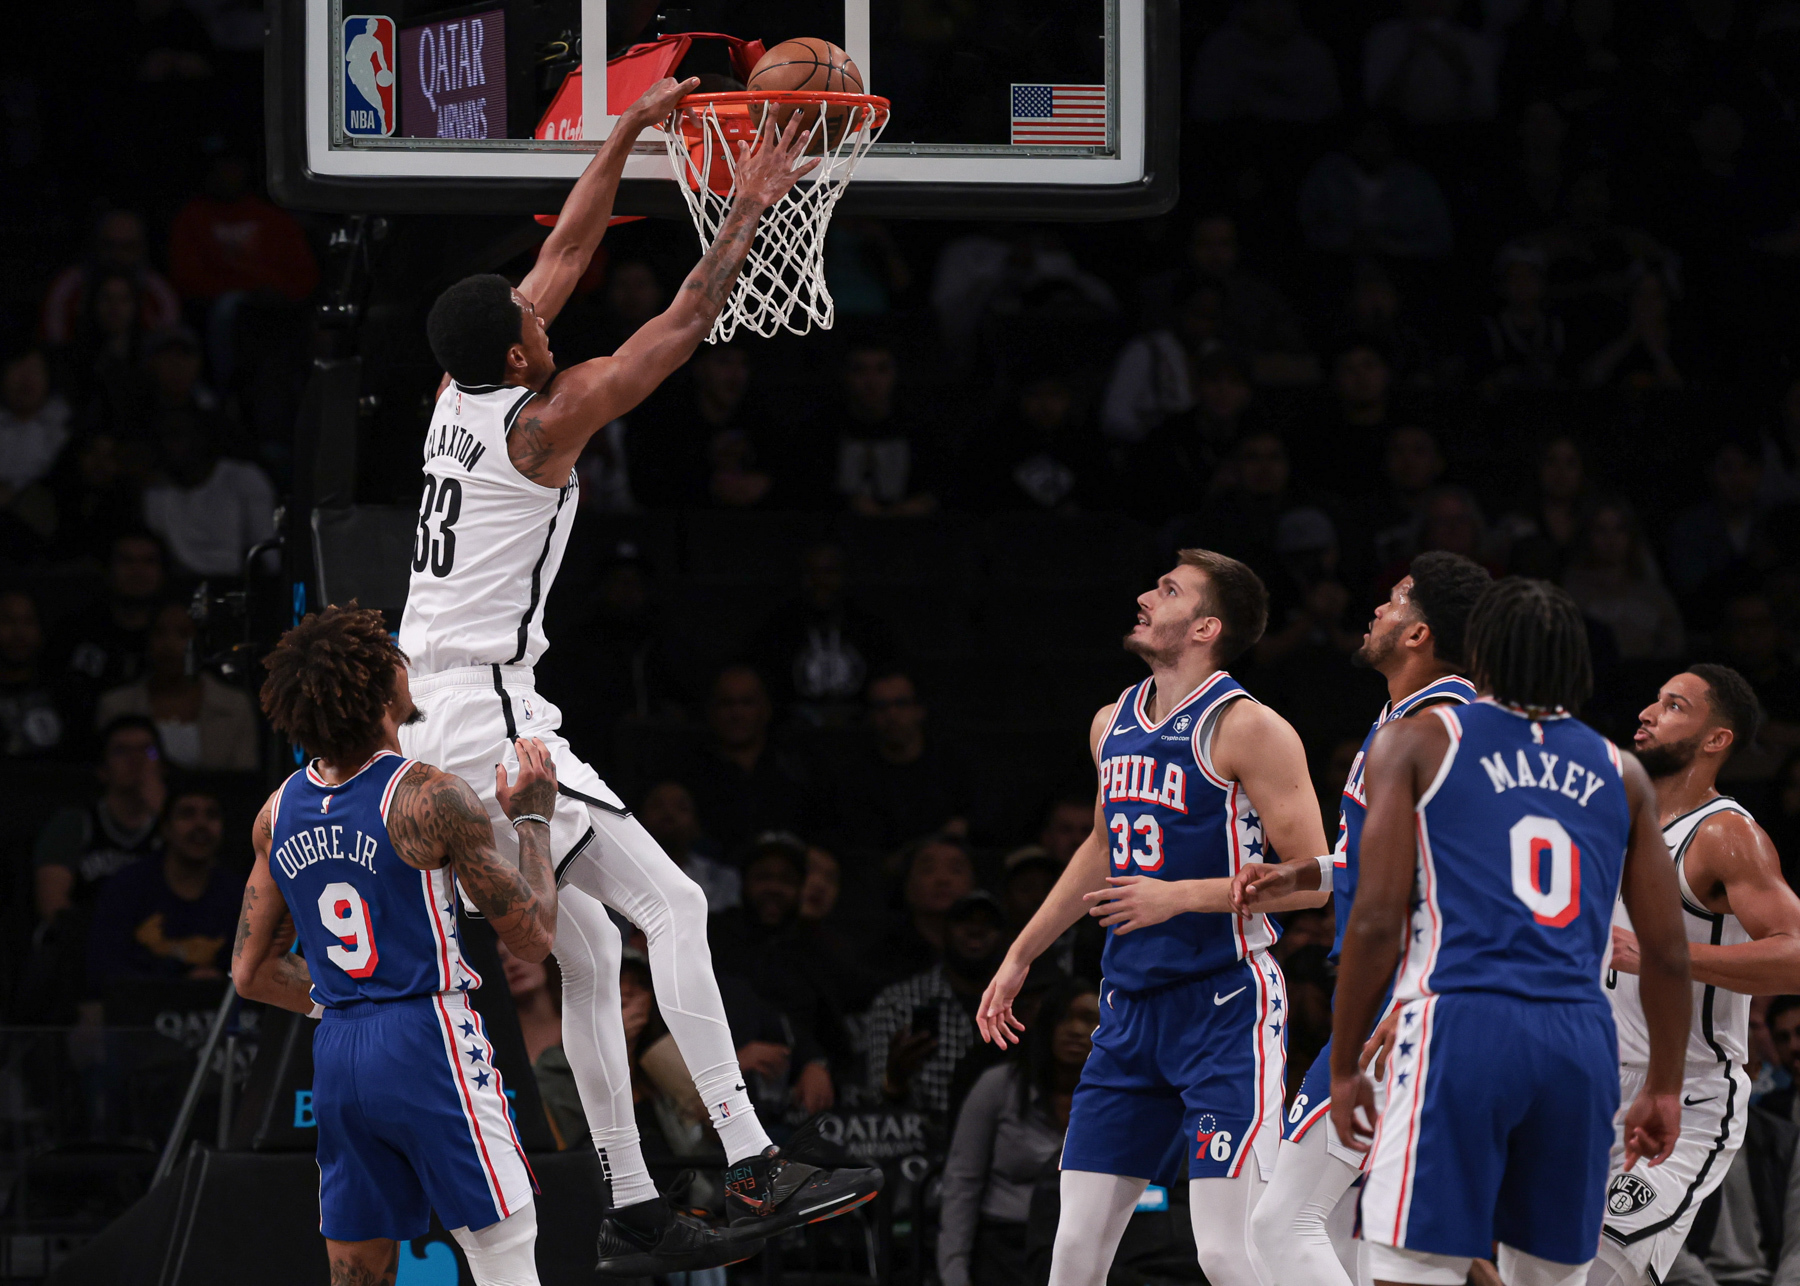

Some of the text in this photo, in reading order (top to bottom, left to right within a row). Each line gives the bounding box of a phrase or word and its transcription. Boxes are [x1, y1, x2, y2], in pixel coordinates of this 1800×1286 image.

[419, 19, 486, 112] QATAR
[350, 110, 376, 129] NBA
[413, 473, 463, 578] 33
[1100, 755, 1188, 814] PHILA
[1480, 749, 1605, 807] MAXEY
[276, 825, 378, 879] OUBRE JR.
[1110, 813, 1165, 871] 33
[1509, 815, 1581, 928] 0
[317, 882, 379, 979] 9
[815, 1113, 924, 1146] QATAR
[1195, 1130, 1232, 1162] 76
[1611, 1176, 1652, 1205] NETS
[1615, 1195, 1628, 1210] B
